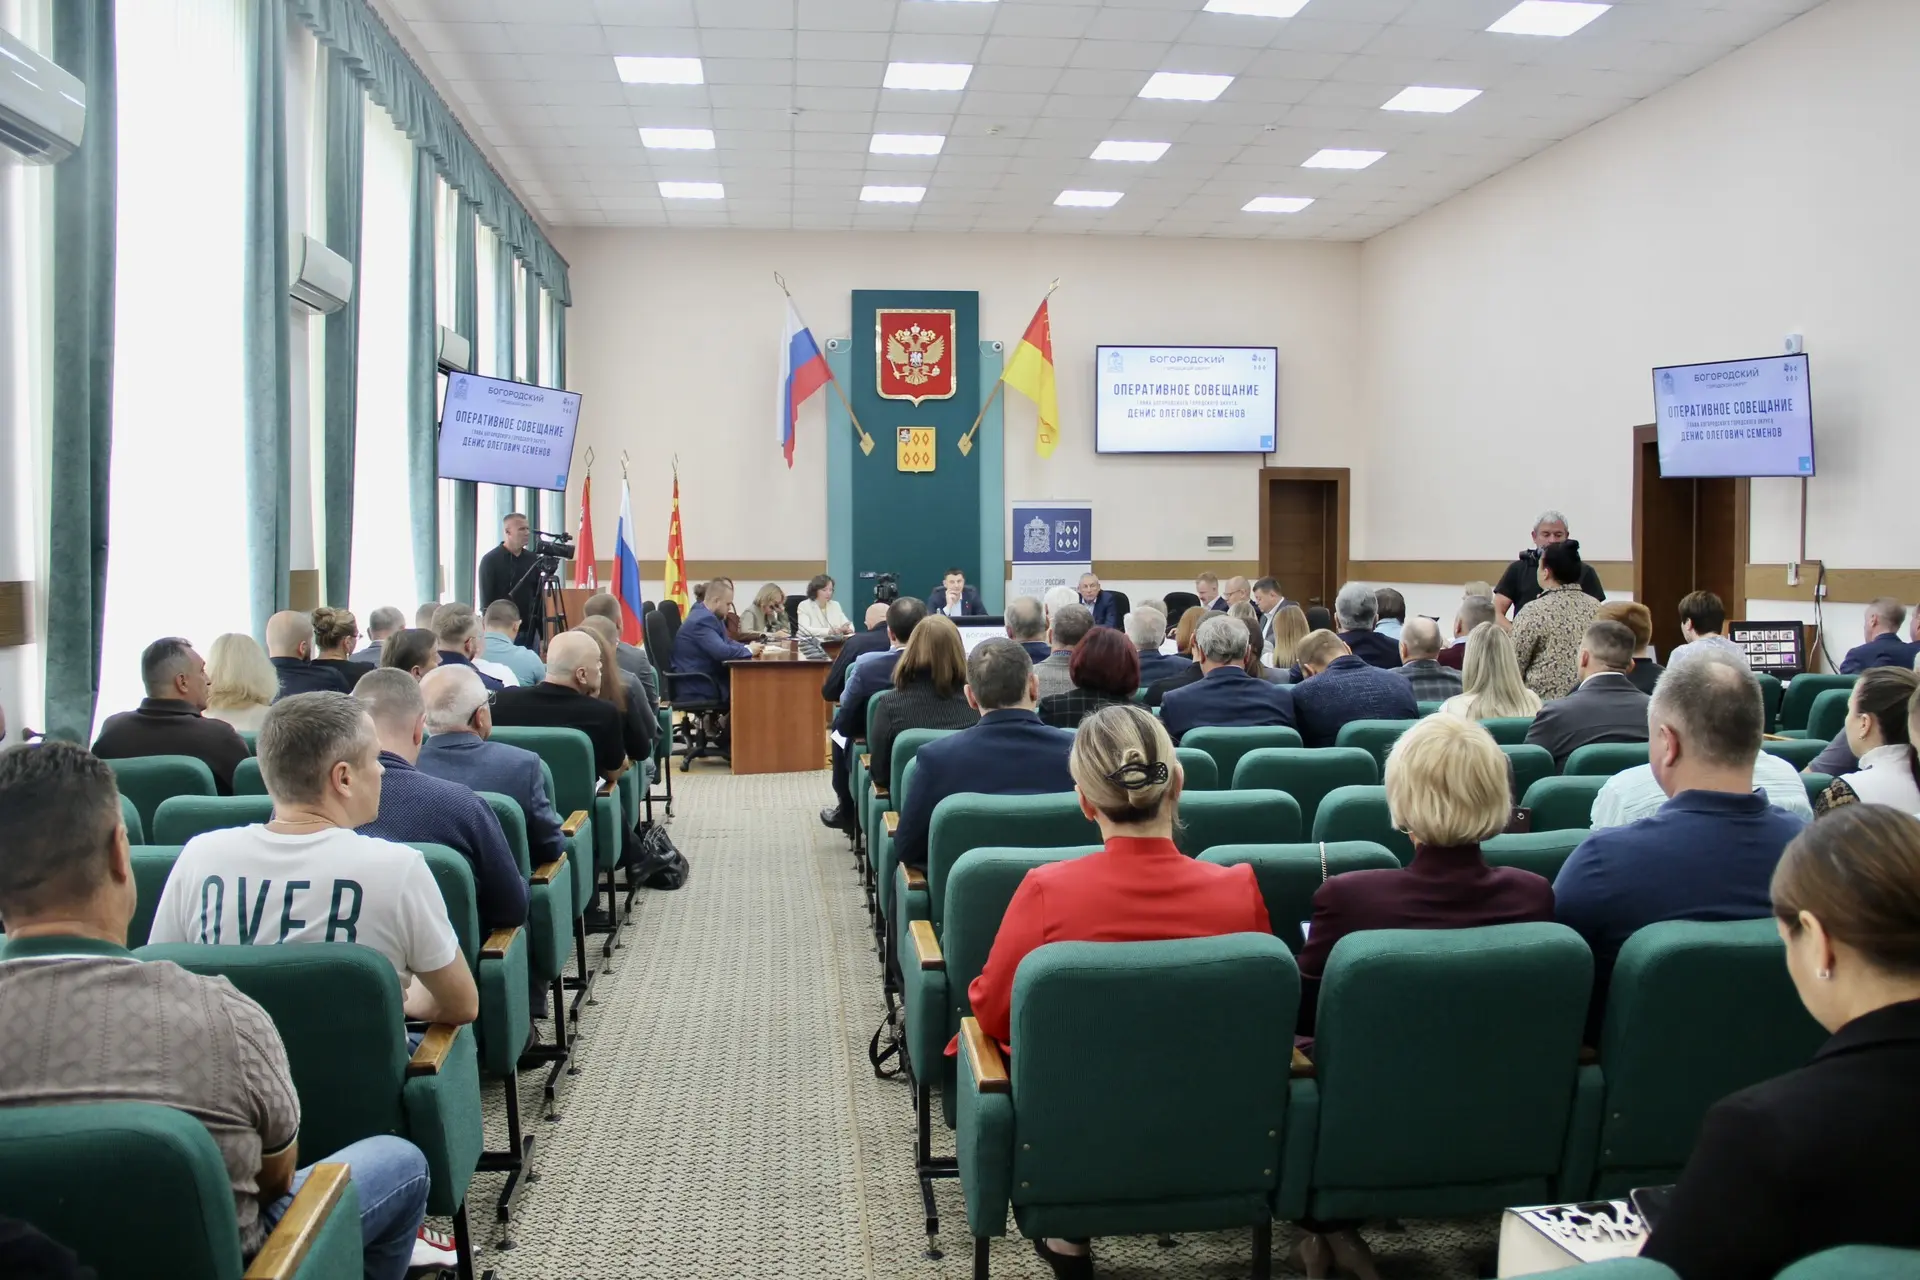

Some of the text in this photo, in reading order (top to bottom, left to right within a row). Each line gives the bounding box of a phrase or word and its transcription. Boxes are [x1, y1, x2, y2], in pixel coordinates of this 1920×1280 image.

[1149, 354, 1225, 364] БОГОРОДСКИЙ
[1694, 367, 1760, 382] БОГОРОДСКИЙ
[488, 386, 544, 403] БОГОРОДСКИЙ
[1113, 383, 1259, 397] ОПЕРАТИВНОЕ СОВЕЩАНИЕ
[1127, 408, 1246, 419] ДЕНИС ОЛЕГОВИЧ СЕМЕНОВ
[1668, 398, 1793, 418] ОПЕРАТИВНОЕ СОВЕЩАНИЕ
[455, 410, 565, 438] ОПЕРАТИВНОЕ СОВЕЩАНИЕ
[1681, 427, 1782, 442] ДЕНИС ОЛЕГОВИЧ СЕМЕНОВ
[462, 436, 551, 457] ДЕНИС ОЛЕГОВИЧ СЕМЕНОВ
[1045, 578, 1066, 586] РОССИЯ
[200, 875, 363, 945] OVER
